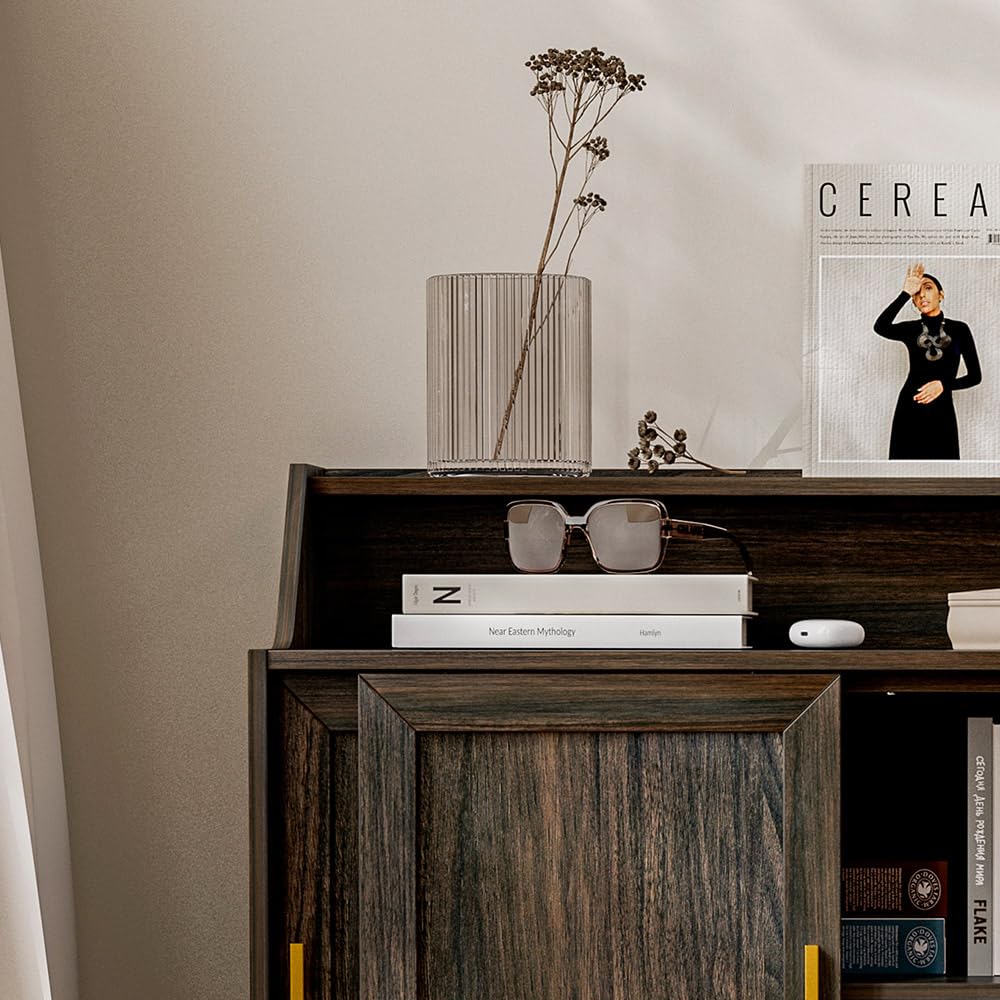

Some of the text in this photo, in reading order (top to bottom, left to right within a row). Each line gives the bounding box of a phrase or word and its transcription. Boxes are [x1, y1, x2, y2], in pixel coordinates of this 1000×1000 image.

[488, 627, 576, 638] Near Eastern Mythology
[639, 629, 662, 637] Hamlyn
[974, 755, 986, 886] СЕГОДНЯ ДЕНЬ РОЖДЕНИЯ МИРА
[973, 899, 987, 945] FLAKE
